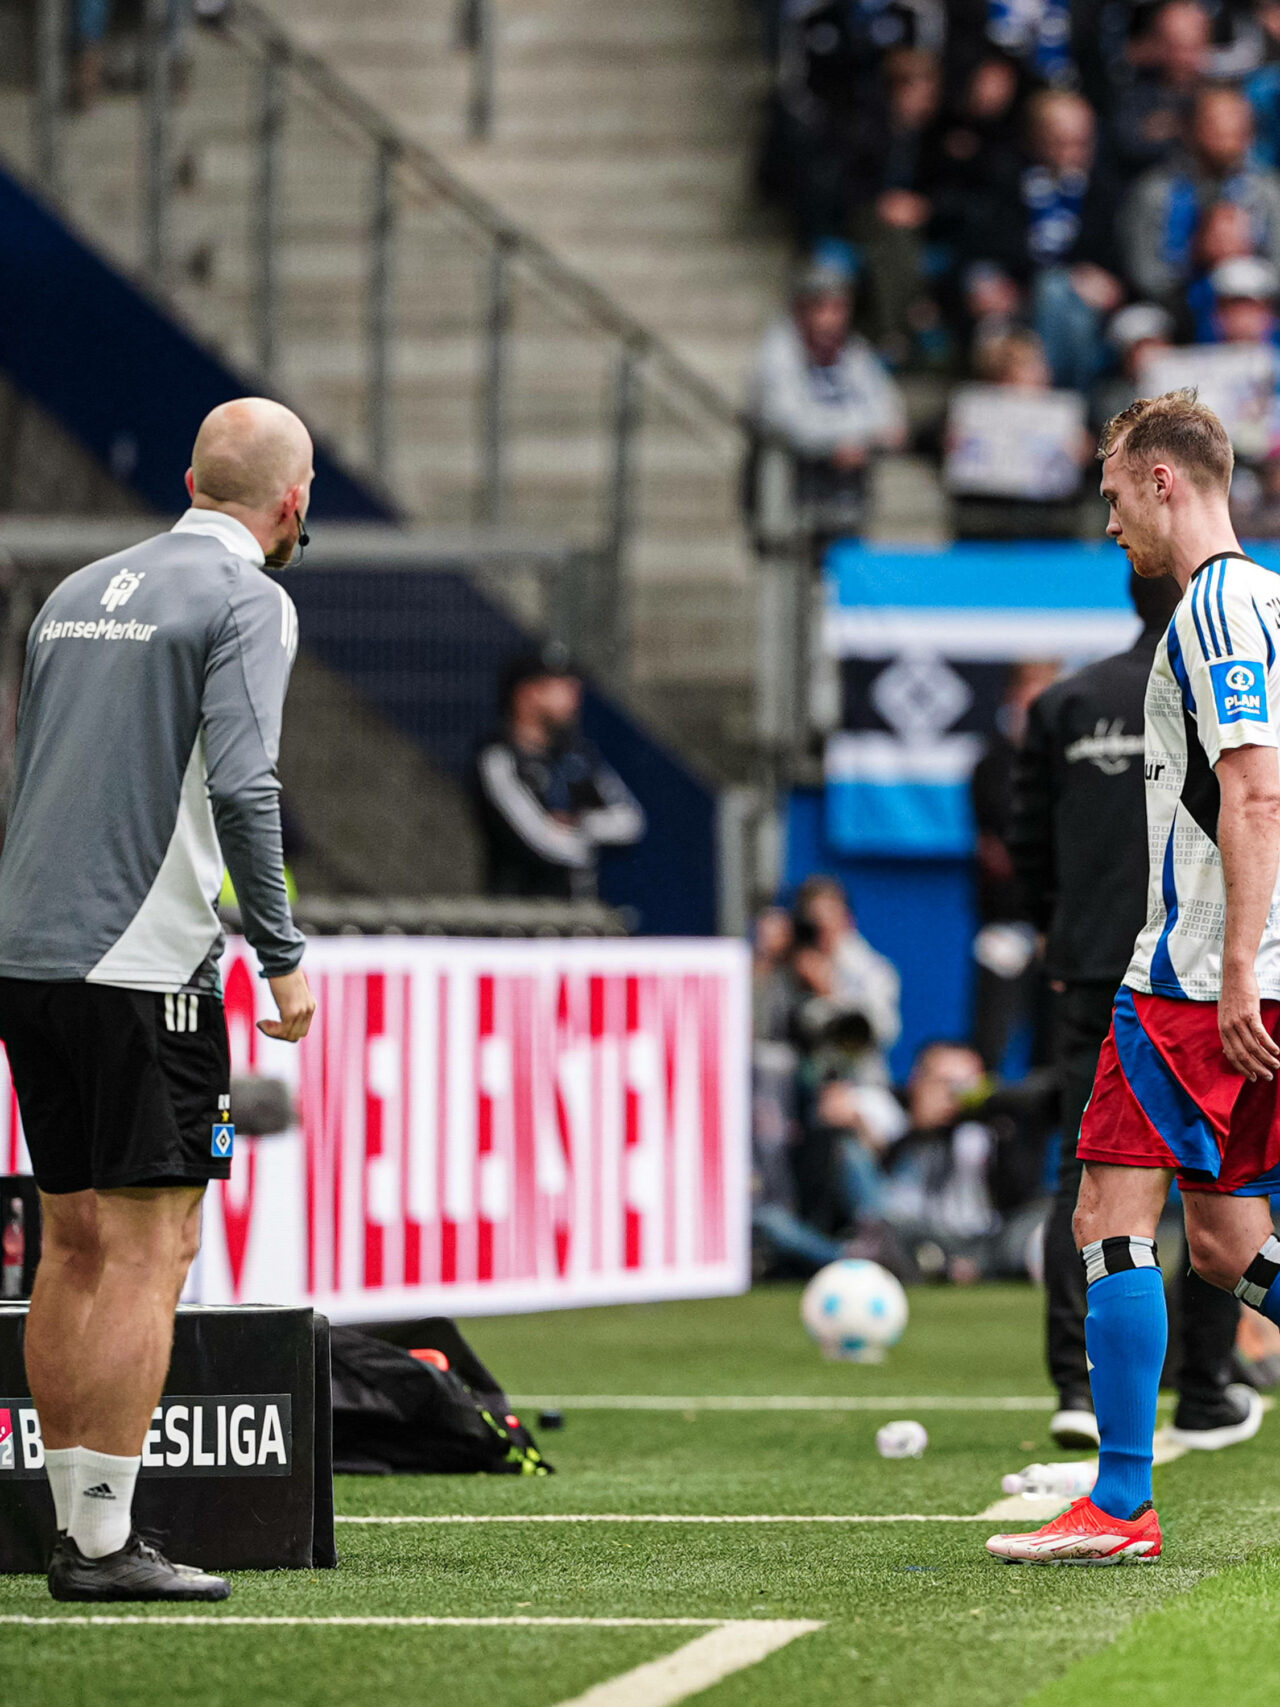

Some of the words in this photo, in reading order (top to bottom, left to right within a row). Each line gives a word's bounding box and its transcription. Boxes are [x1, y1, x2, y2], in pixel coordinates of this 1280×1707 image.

[39, 618, 158, 643] HanseMerkur
[1224, 694, 1262, 710] PLAN
[18, 1404, 288, 1470] BESLIGA
